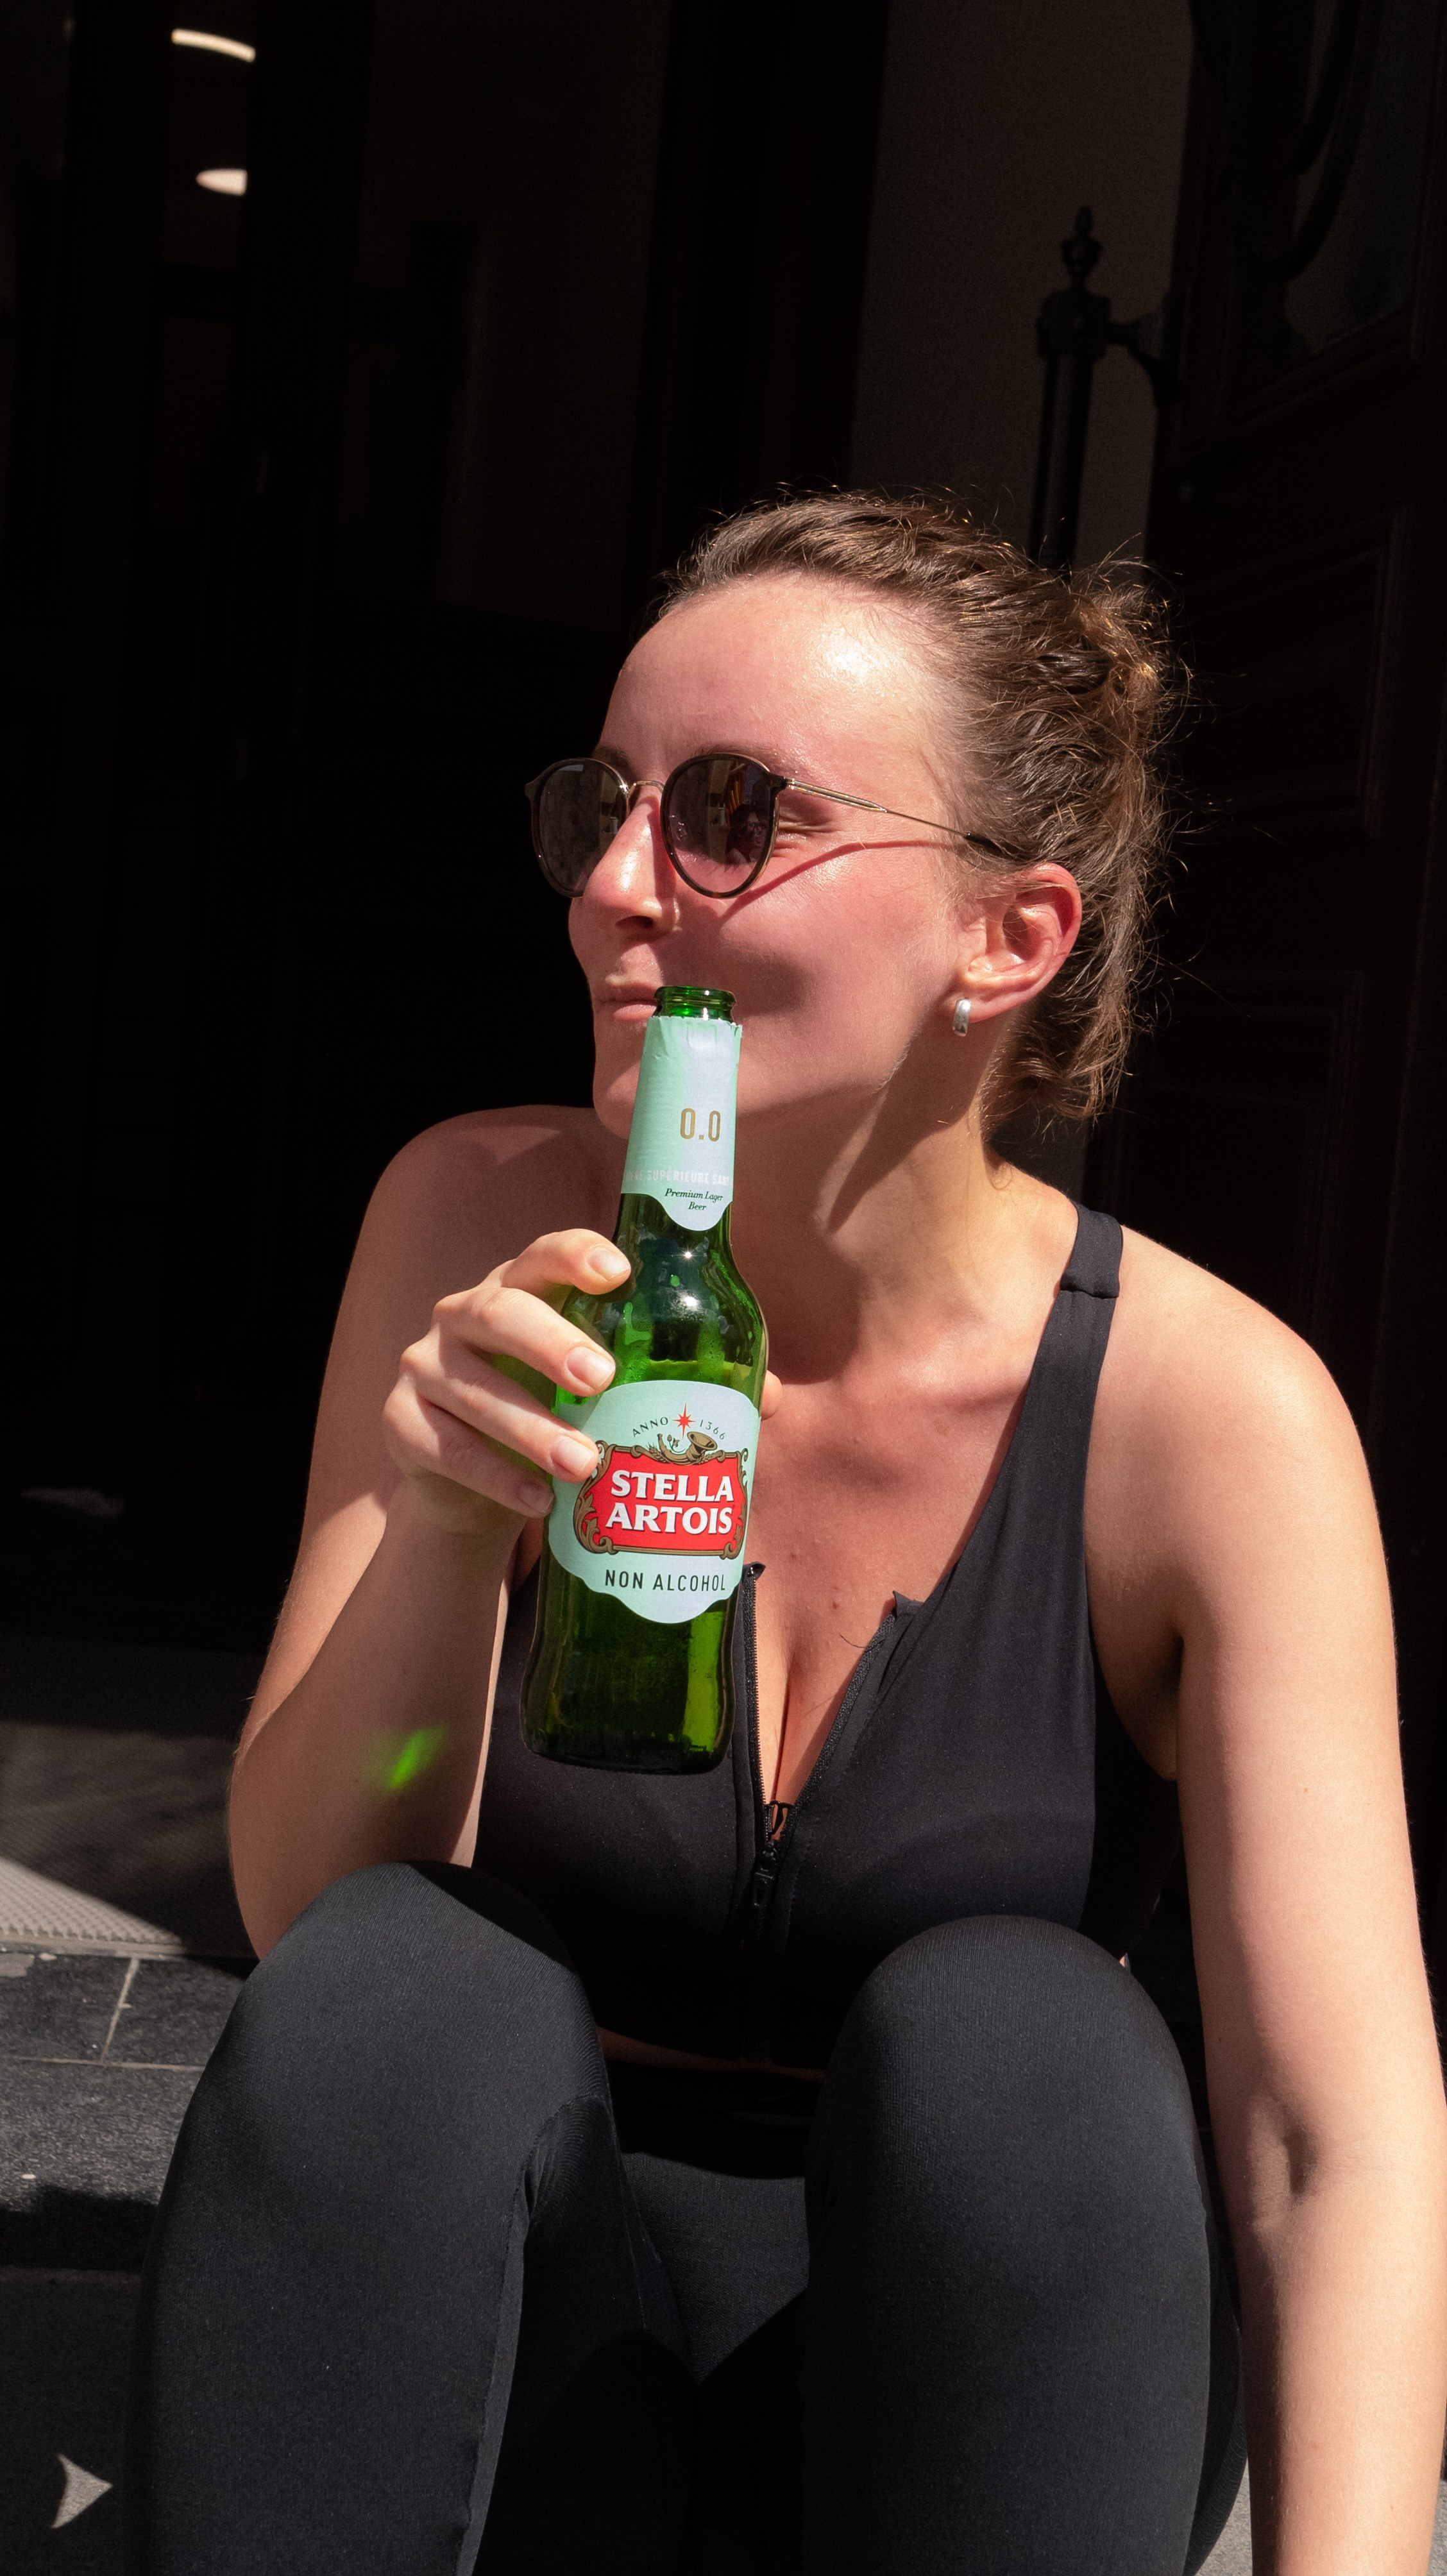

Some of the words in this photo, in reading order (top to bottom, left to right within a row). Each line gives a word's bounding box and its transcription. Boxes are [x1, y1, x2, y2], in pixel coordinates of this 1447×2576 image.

[679, 1107, 721, 1142] 0.0
[664, 1188, 704, 1199] Premium
[704, 1191, 724, 1203] Lager
[688, 1201, 707, 1211] Beer
[632, 1416, 668, 1437] ANNO
[699, 1419, 725, 1440] 1366
[611, 1470, 734, 1502] STELLA
[605, 1502, 734, 1535] ARTOIS
[605, 1569, 643, 1589] NON
[652, 1573, 726, 1592] ALCOHOL
